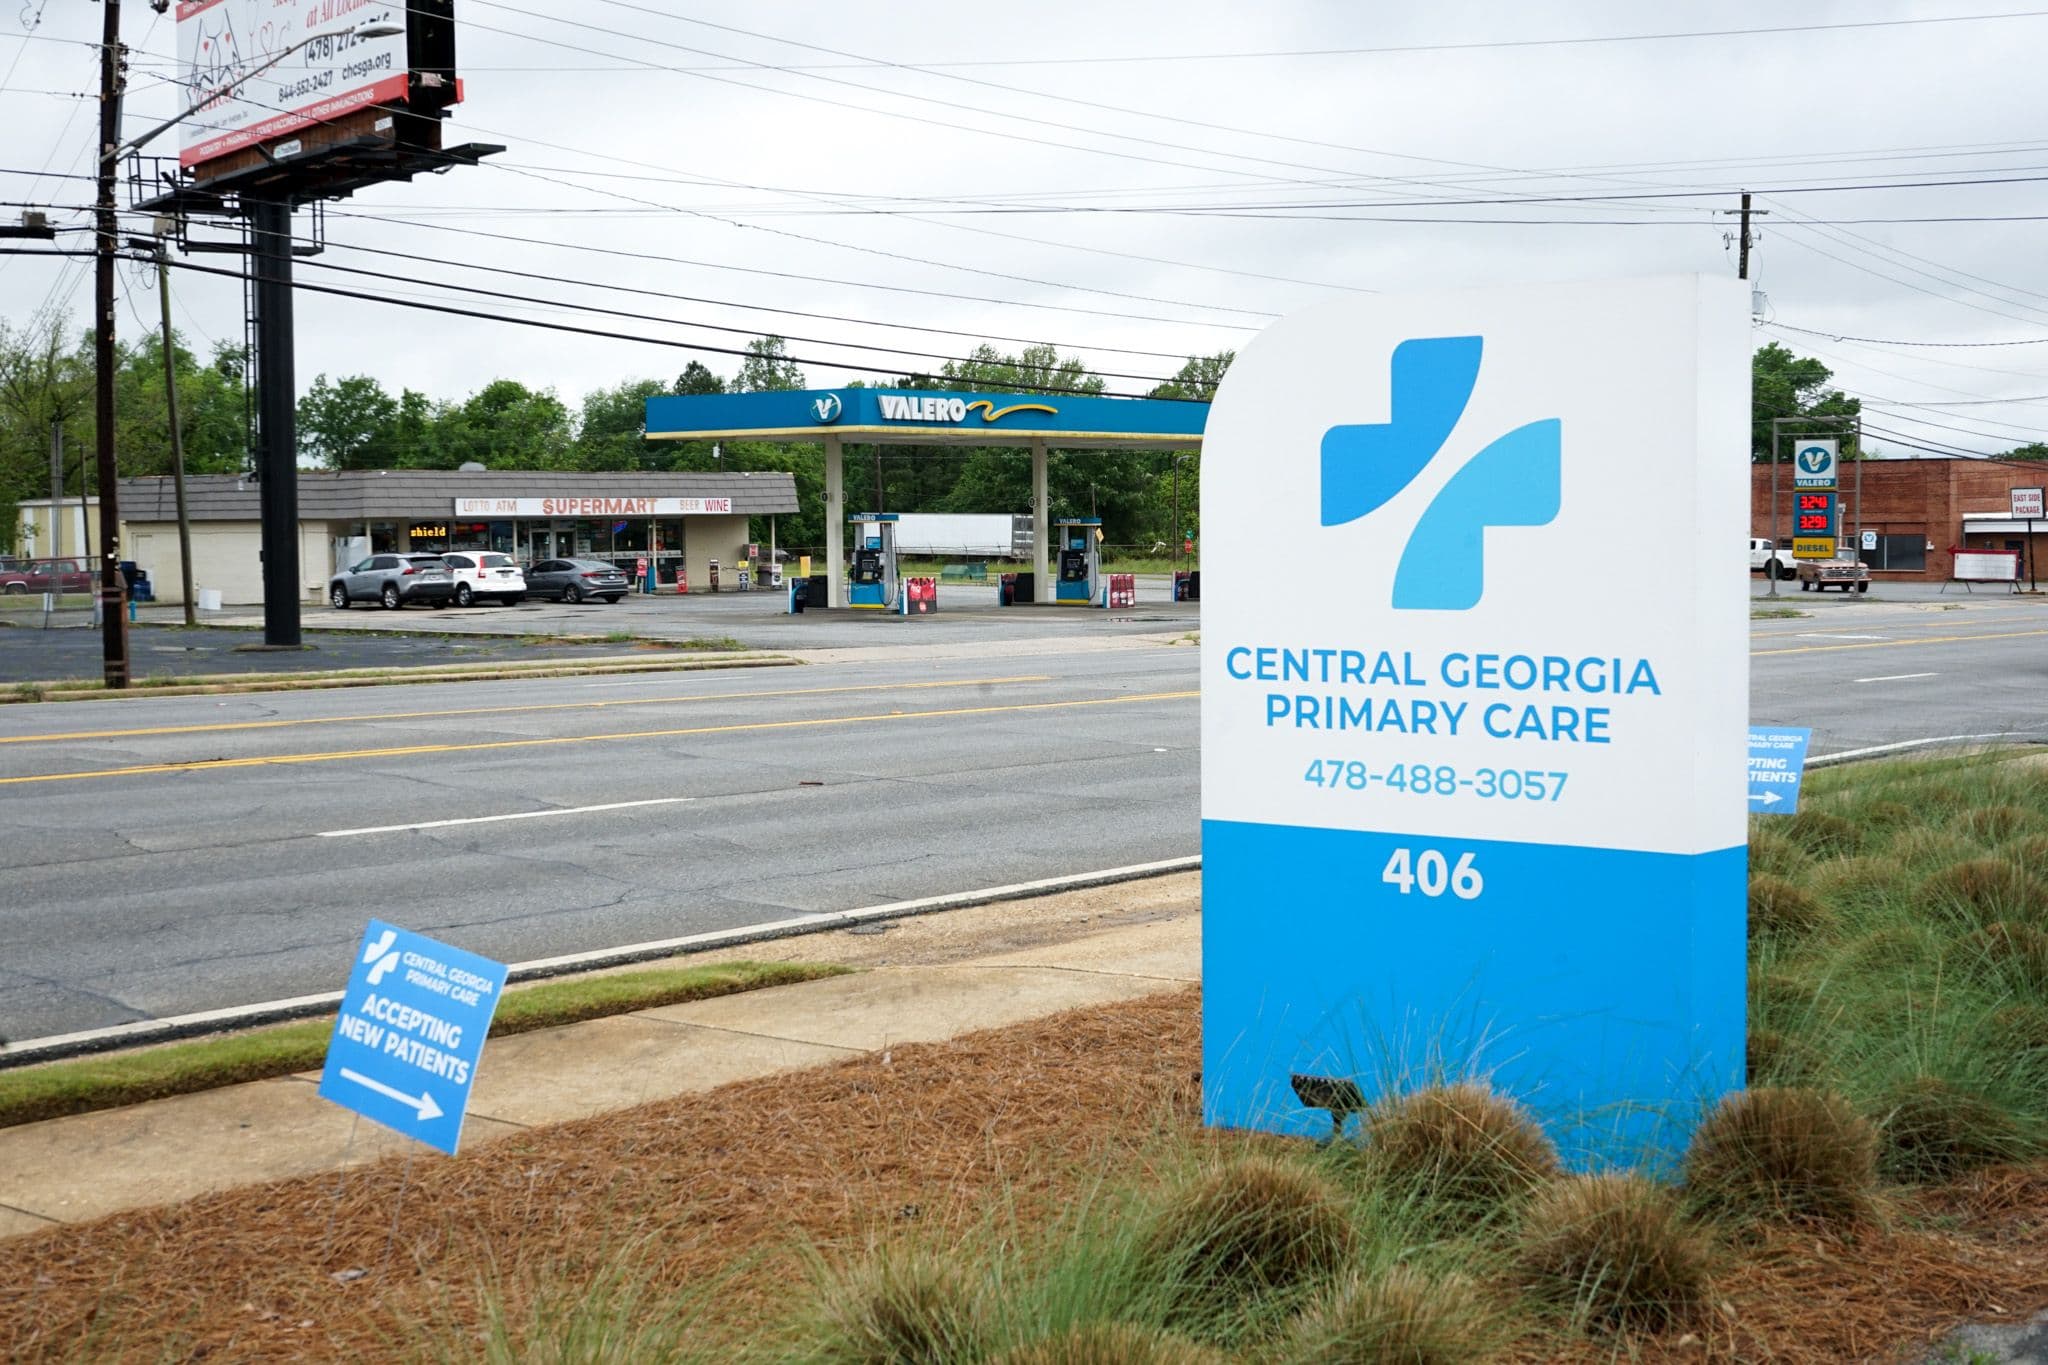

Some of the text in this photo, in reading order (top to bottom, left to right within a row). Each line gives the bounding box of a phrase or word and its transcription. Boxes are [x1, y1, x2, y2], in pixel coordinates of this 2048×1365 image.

[342, 52, 391, 80] chcsga.org
[878, 395, 967, 423] VALERO
[1796, 479, 1831, 487] VALERO
[463, 500, 518, 513] LOTTO ATM
[543, 497, 657, 515] SUPERMART
[680, 499, 729, 512] BEER WINE
[2013, 494, 2041, 502] EAST SIDE
[2015, 505, 2040, 514] PACKAGE
[410, 526, 446, 537] shield
[1796, 544, 1830, 552] DIESEL
[1226, 646, 1662, 696] CENTRAL GEORGIA
[1266, 694, 1611, 743] PRIMARY CARE
[1749, 757, 1788, 769] PTING
[1304, 759, 1569, 802] 478-488-3057
[1749, 770, 1797, 783] TIENTS
[1382, 848, 1484, 899] 406
[403, 952, 494, 994] CENTRAL GEORGIA
[405, 970, 481, 1006] PRIMARY CARE
[360, 993, 463, 1049] ACCEPTING
[338, 1013, 471, 1085] NEW PATIENTS
